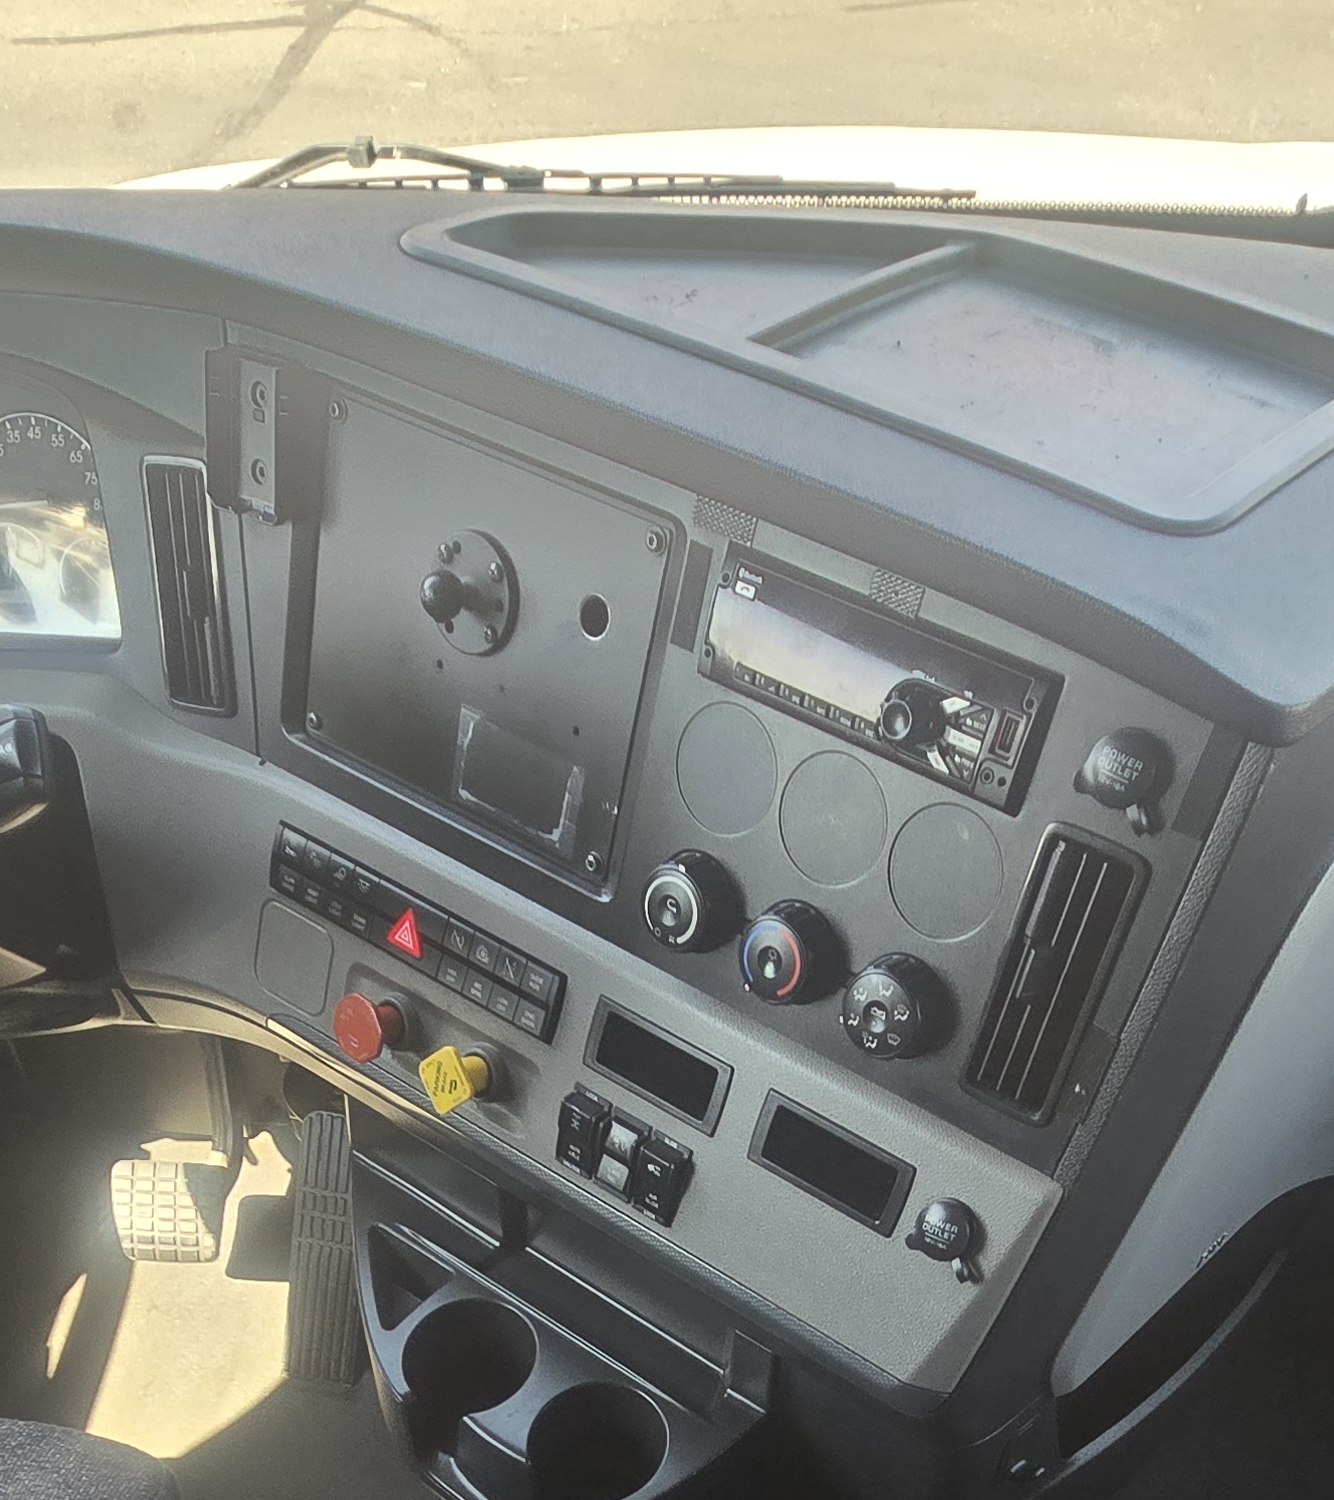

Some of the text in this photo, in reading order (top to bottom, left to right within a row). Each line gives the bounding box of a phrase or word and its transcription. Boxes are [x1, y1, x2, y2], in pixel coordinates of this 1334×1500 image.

[6, 430, 21, 444] 35
[27, 426, 42, 439] 45
[51, 433, 65, 447] 55
[69, 450, 83, 463] 65
[84, 472, 98, 485] 75
[93, 499, 103, 511] 8
[1103, 745, 1143, 771] POWER
[1097, 756, 1140, 781] OUTLET
[433, 1060, 443, 1098] PARKING
[924, 1213, 958, 1234] POWER
[922, 1222, 956, 1242] OUTLET
